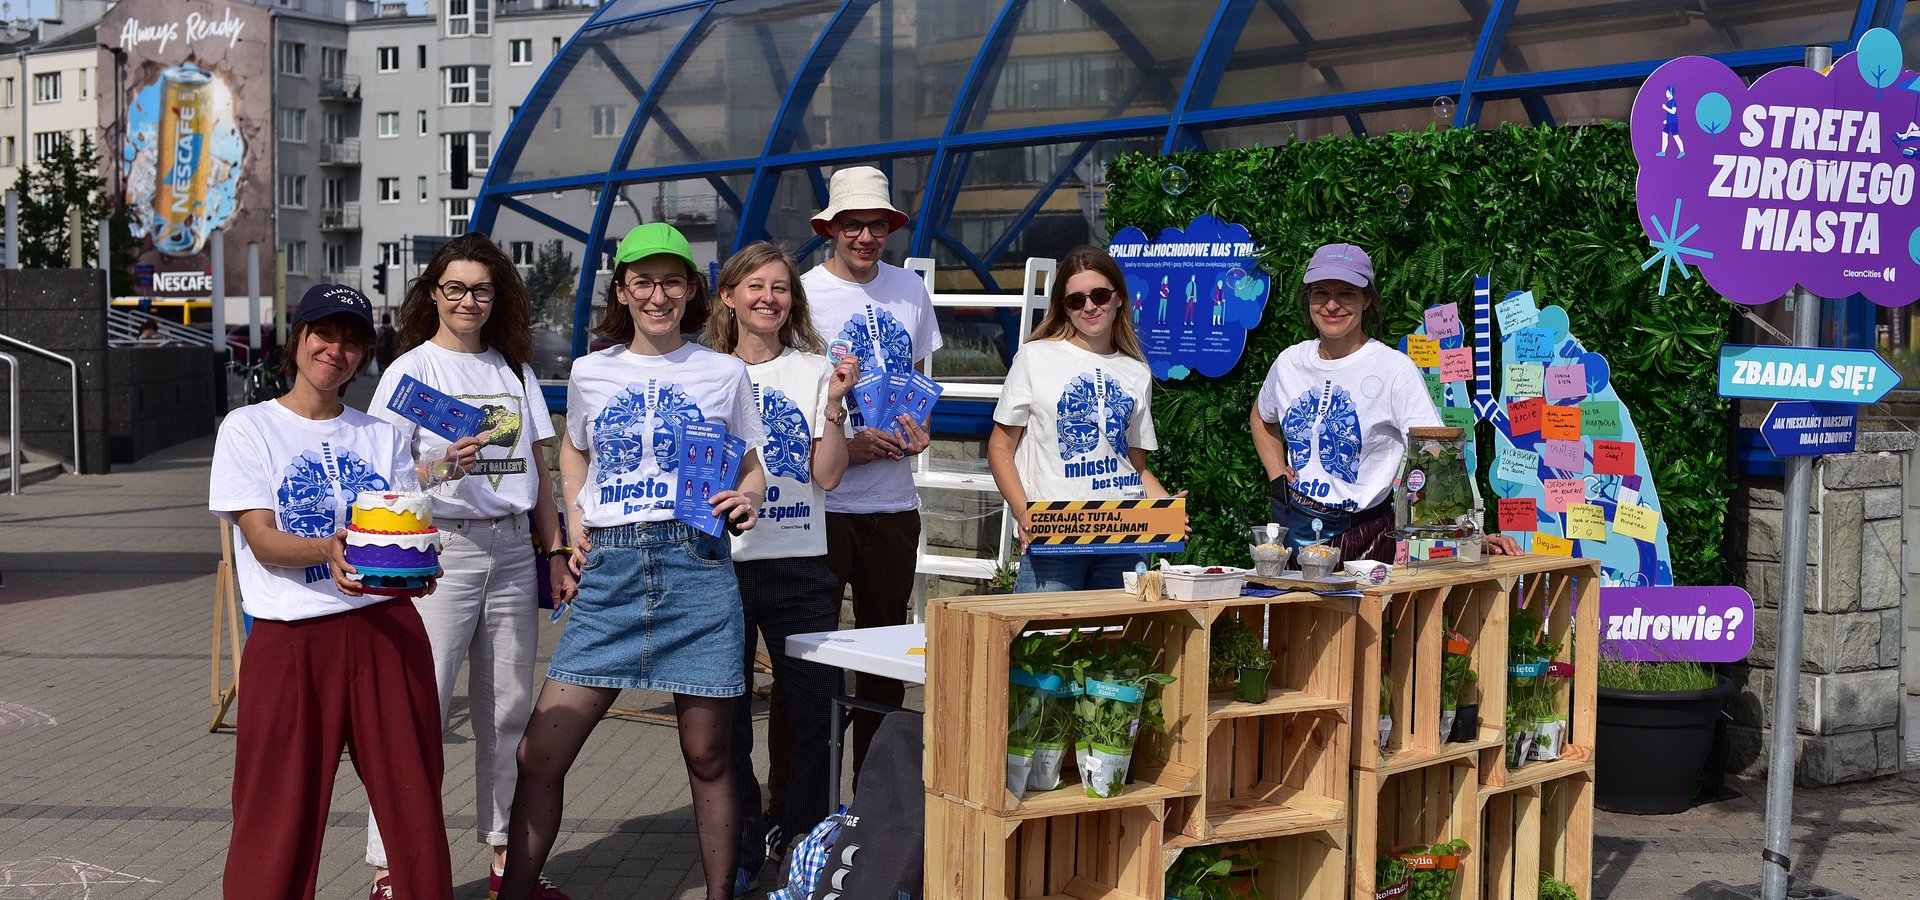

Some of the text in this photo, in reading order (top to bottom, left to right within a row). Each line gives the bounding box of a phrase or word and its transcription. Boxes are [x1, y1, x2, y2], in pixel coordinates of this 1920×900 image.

[120, 7, 245, 54] Always Ready
[1739, 104, 1881, 154] STREFA
[1708, 154, 1915, 206] ZDROWEGO
[1741, 207, 1880, 255] MIASTA
[1108, 243, 1143, 257] SPALINY
[1143, 243, 1210, 257] SAMOCHODOWE
[1211, 243, 1231, 257] NAS
[1843, 269, 1882, 278] CleanCities
[337, 295, 354, 305] '26
[1731, 360, 1877, 396] ZBADAJ SIĘ!
[1509, 400, 1529, 411] SPORT
[1772, 414, 1854, 430] JAK MIESZKAŃCY WARSZAWY
[1800, 432, 1853, 447] DBAJĄ O ZDROWIE?
[470, 461, 523, 473] OFT GALLERY
[1064, 455, 1118, 478] miasto
[599, 477, 669, 505] miasto
[1092, 478, 1112, 490] bez
[1299, 479, 1331, 497] sto
[623, 501, 651, 516] bez
[768, 501, 811, 522] spalin
[1031, 512, 1123, 524] CZEKAJĄC TUTAJ,
[1031, 523, 1148, 534] ODDYCHASZ SPALINAMI
[1536, 536, 1562, 551] Biegam
[1606, 605, 1744, 641] zdrowie?
[1401, 857, 1433, 870] zylia
[1375, 881, 1409, 900] kolendr
